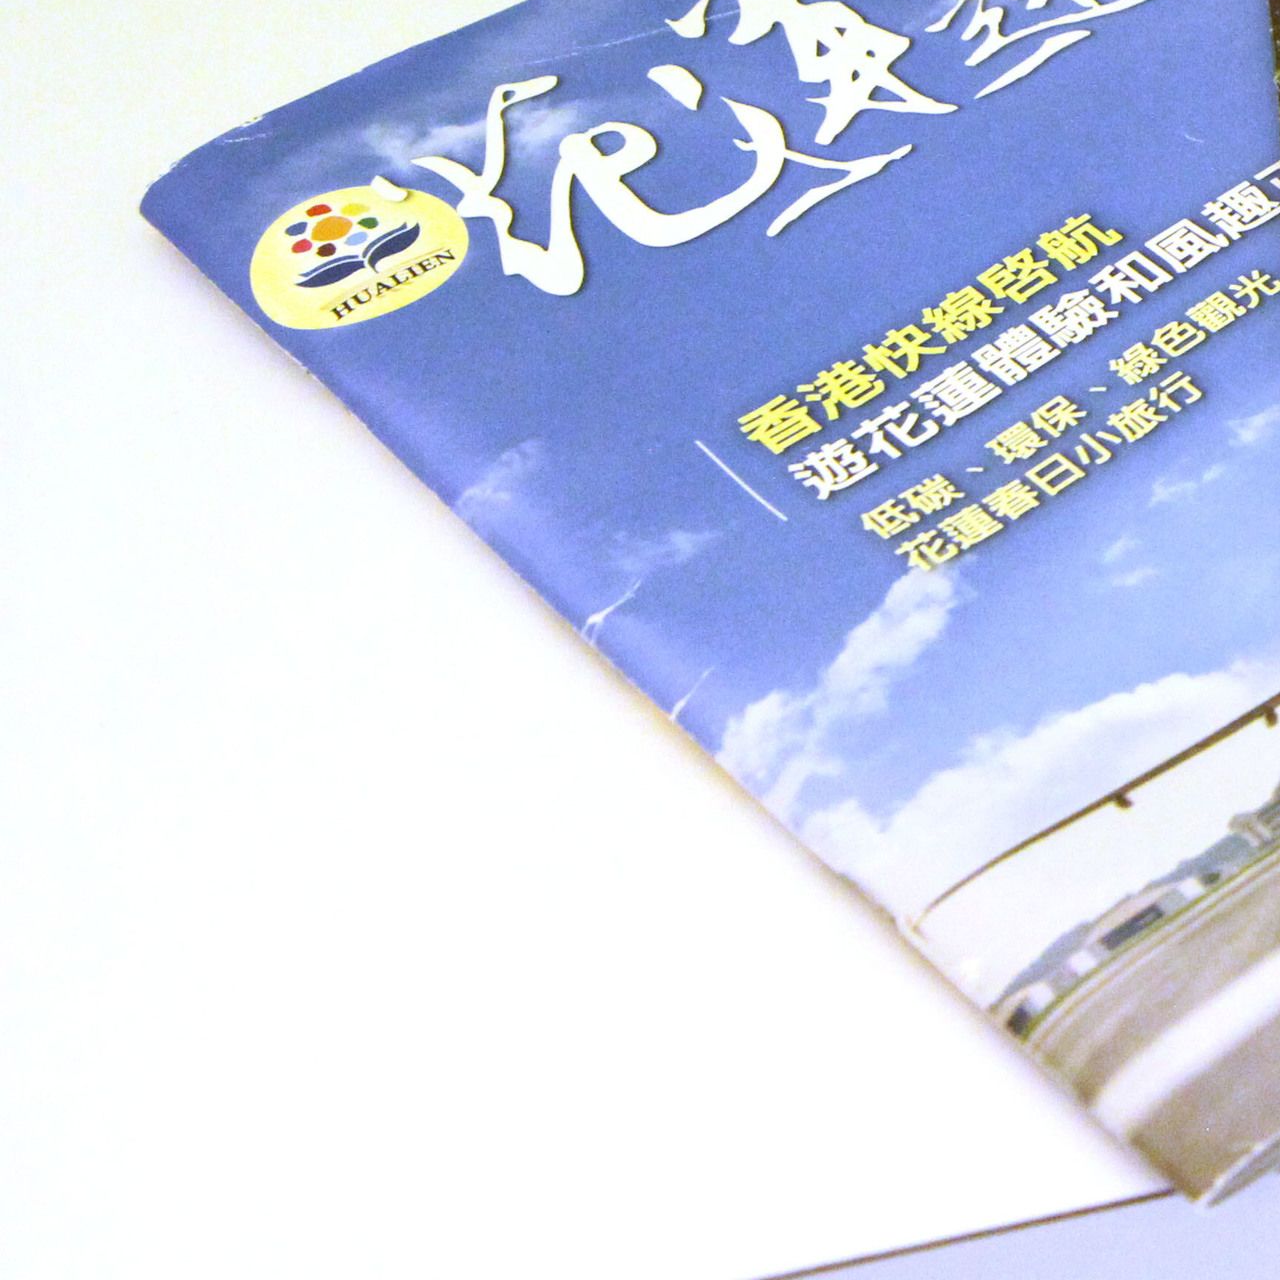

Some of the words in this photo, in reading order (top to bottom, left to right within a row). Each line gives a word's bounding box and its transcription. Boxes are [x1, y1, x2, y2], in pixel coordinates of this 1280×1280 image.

[330, 249, 457, 321] HUALIEN
[895, 370, 1204, 575] 花蓮春日小旅行
